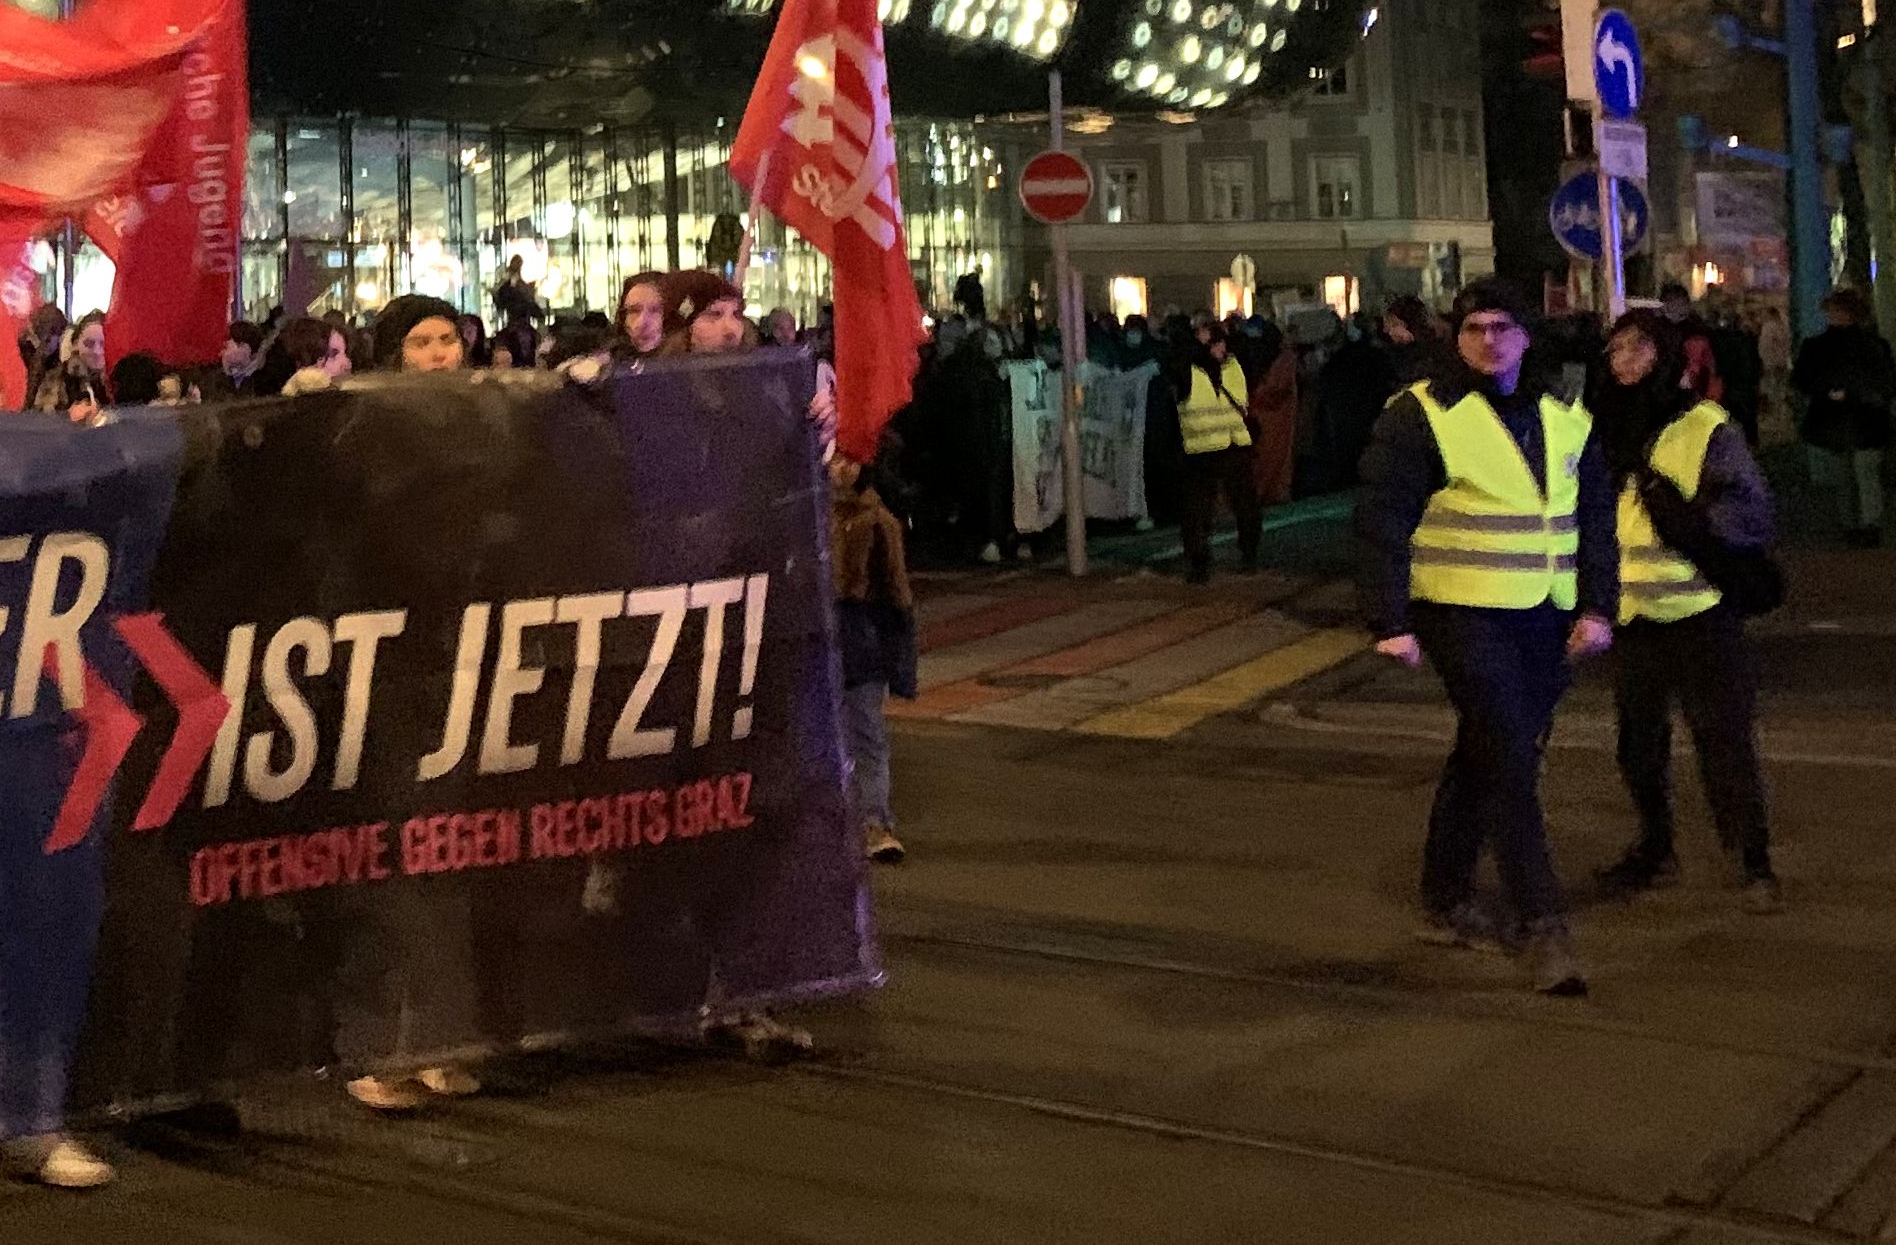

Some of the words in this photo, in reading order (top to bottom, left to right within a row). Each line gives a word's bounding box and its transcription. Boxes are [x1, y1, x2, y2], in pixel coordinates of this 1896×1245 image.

[188, 133, 235, 275] Jugend
[202, 607, 409, 811] IST
[415, 573, 769, 784] JETZT!
[189, 820, 391, 906] OFFENSIVE
[399, 802, 520, 875] GEGEN
[530, 788, 668, 859] RECHTS
[672, 771, 754, 839] GRAZ
